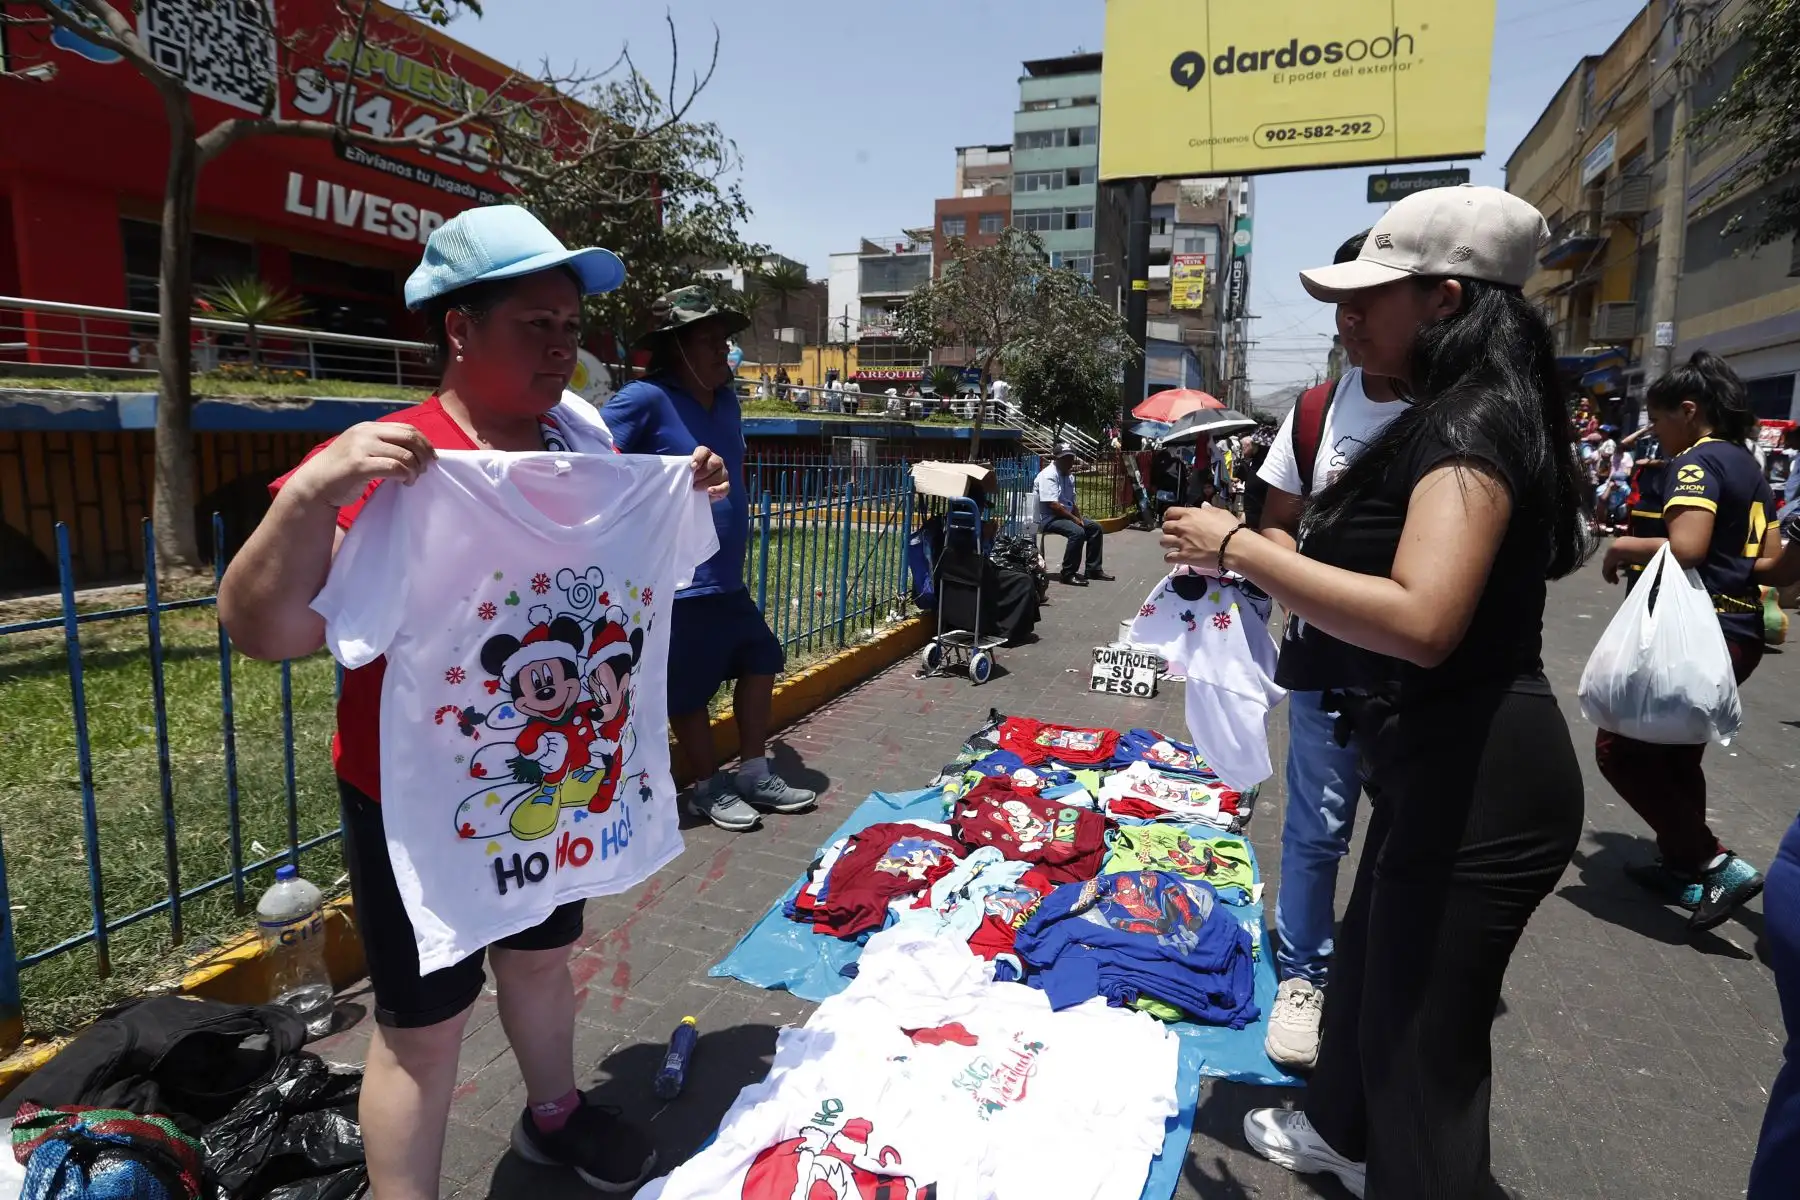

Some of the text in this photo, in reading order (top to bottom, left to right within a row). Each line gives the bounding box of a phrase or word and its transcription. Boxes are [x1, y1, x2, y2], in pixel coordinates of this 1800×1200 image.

[1213, 26, 1414, 76] dardosooh
[1273, 61, 1413, 85] El poder del exterior
[1265, 121, 1373, 142] 902-582-292
[415, 168, 433, 184] tu
[433, 174, 477, 198] jugada
[1674, 484, 1705, 492] AXION
[1094, 649, 1155, 670] CONTROLE
[1111, 665, 1135, 680] SU
[1091, 675, 1150, 696] PESO
[493, 850, 550, 896] HO
[555, 829, 594, 876] HO
